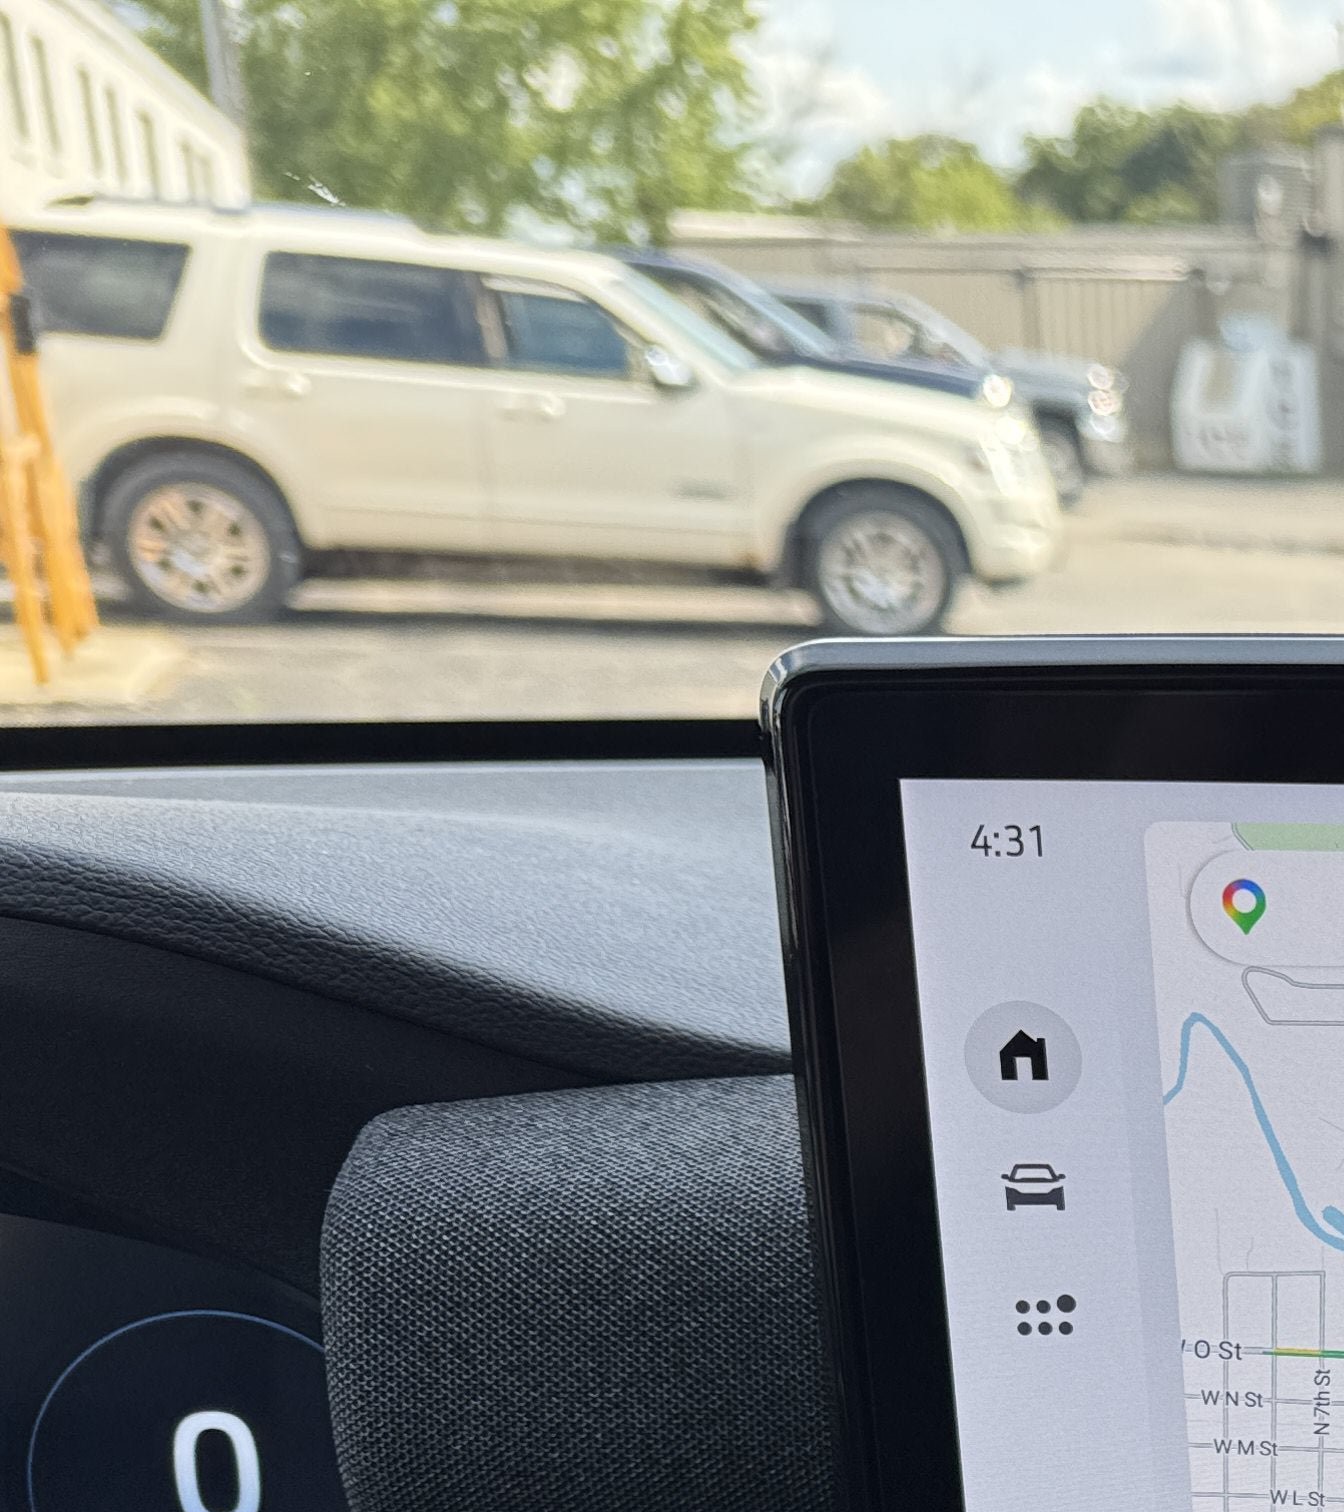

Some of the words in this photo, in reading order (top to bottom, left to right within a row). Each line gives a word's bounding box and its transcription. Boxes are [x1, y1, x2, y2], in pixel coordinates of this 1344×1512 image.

[970, 825, 1044, 858] 4:31
[1194, 1340, 1210, 1358] O
[1218, 1341, 1242, 1360] St
[1313, 1369, 1330, 1386] St
[1201, 1389, 1219, 1405] W
[1225, 1391, 1239, 1406] N
[1244, 1391, 1263, 1408] St
[1313, 1391, 1330, 1417] 7th
[1313, 1422, 1330, 1435] N
[1213, 1438, 1232, 1453] W
[1237, 1440, 1254, 1455] M
[1259, 1440, 1278, 1456] St
[1270, 1489, 1288, 1504] W
[1293, 1490, 1303, 1505] L
[1308, 1491, 1325, 1507] St
